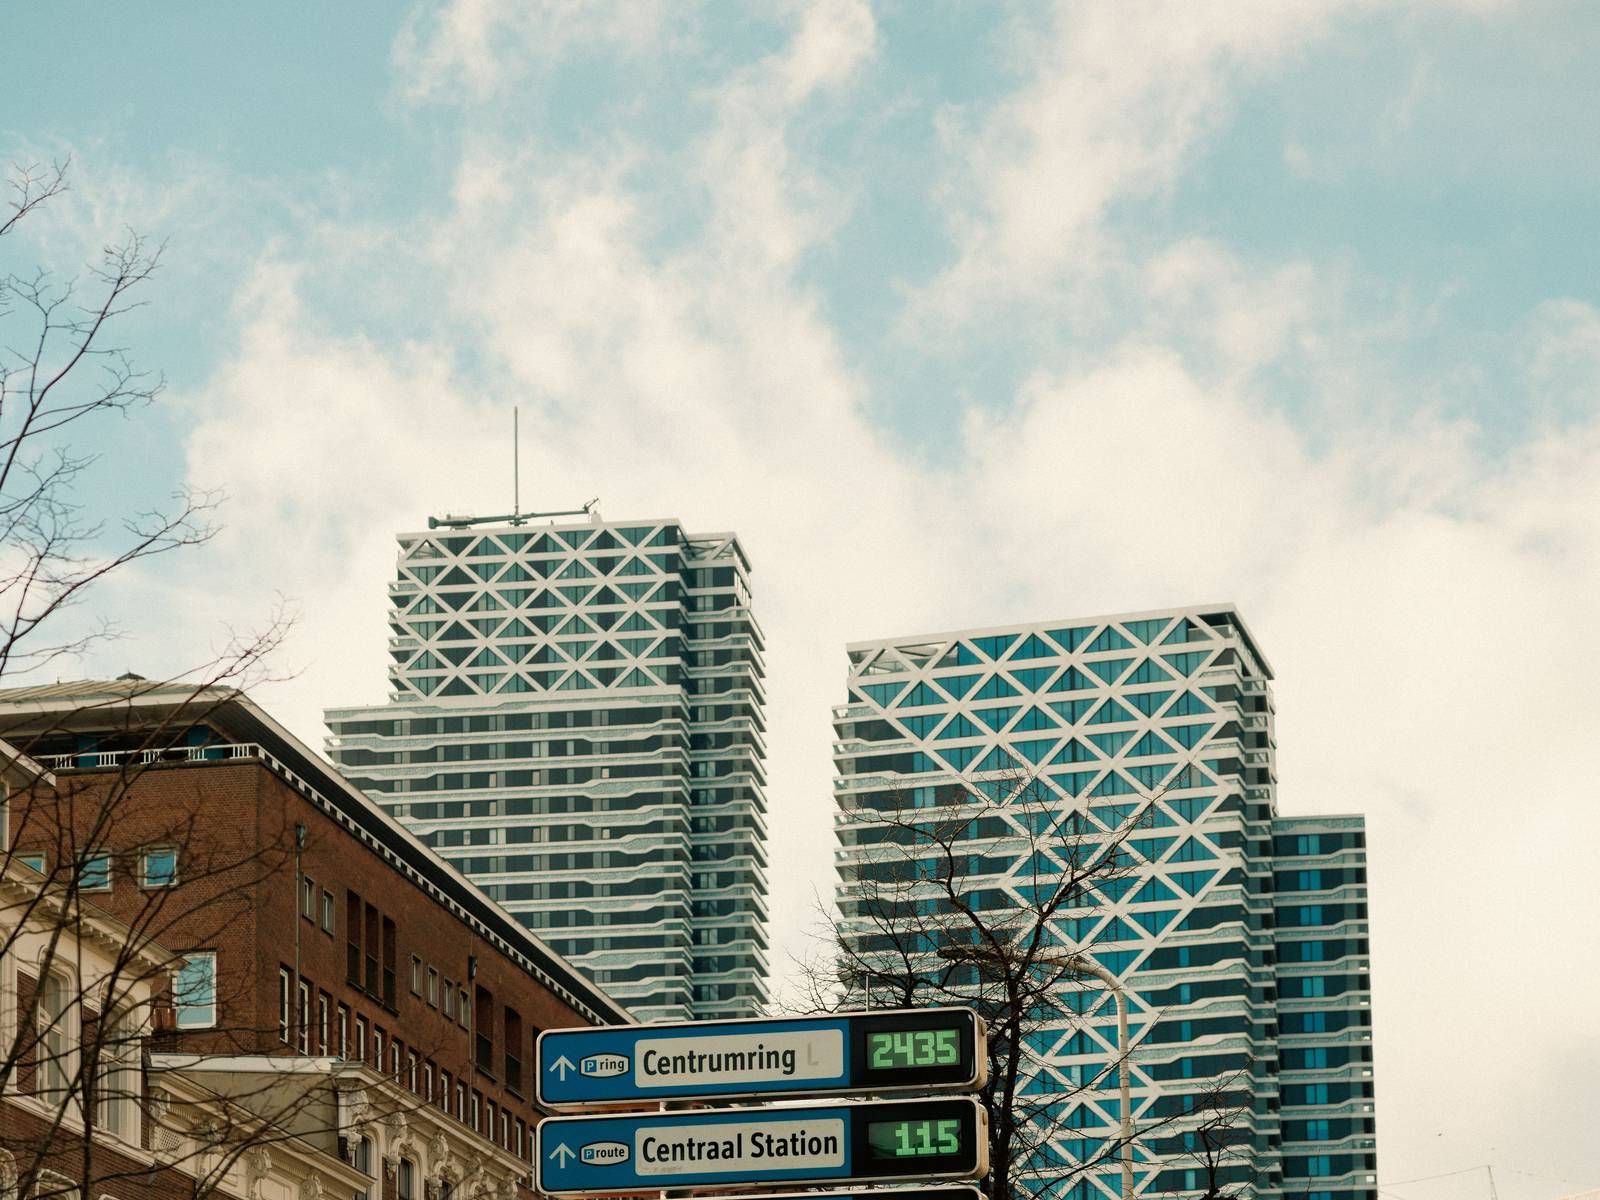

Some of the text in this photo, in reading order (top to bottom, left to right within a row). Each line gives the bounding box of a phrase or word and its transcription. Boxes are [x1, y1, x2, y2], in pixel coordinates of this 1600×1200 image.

[643, 1044, 796, 1075] Centrumring
[872, 1030, 957, 1067] 2435
[587, 1058, 625, 1072] P ring
[596, 1146, 625, 1158] route
[642, 1130, 838, 1163] Centraal Station
[895, 1120, 959, 1156] 115
